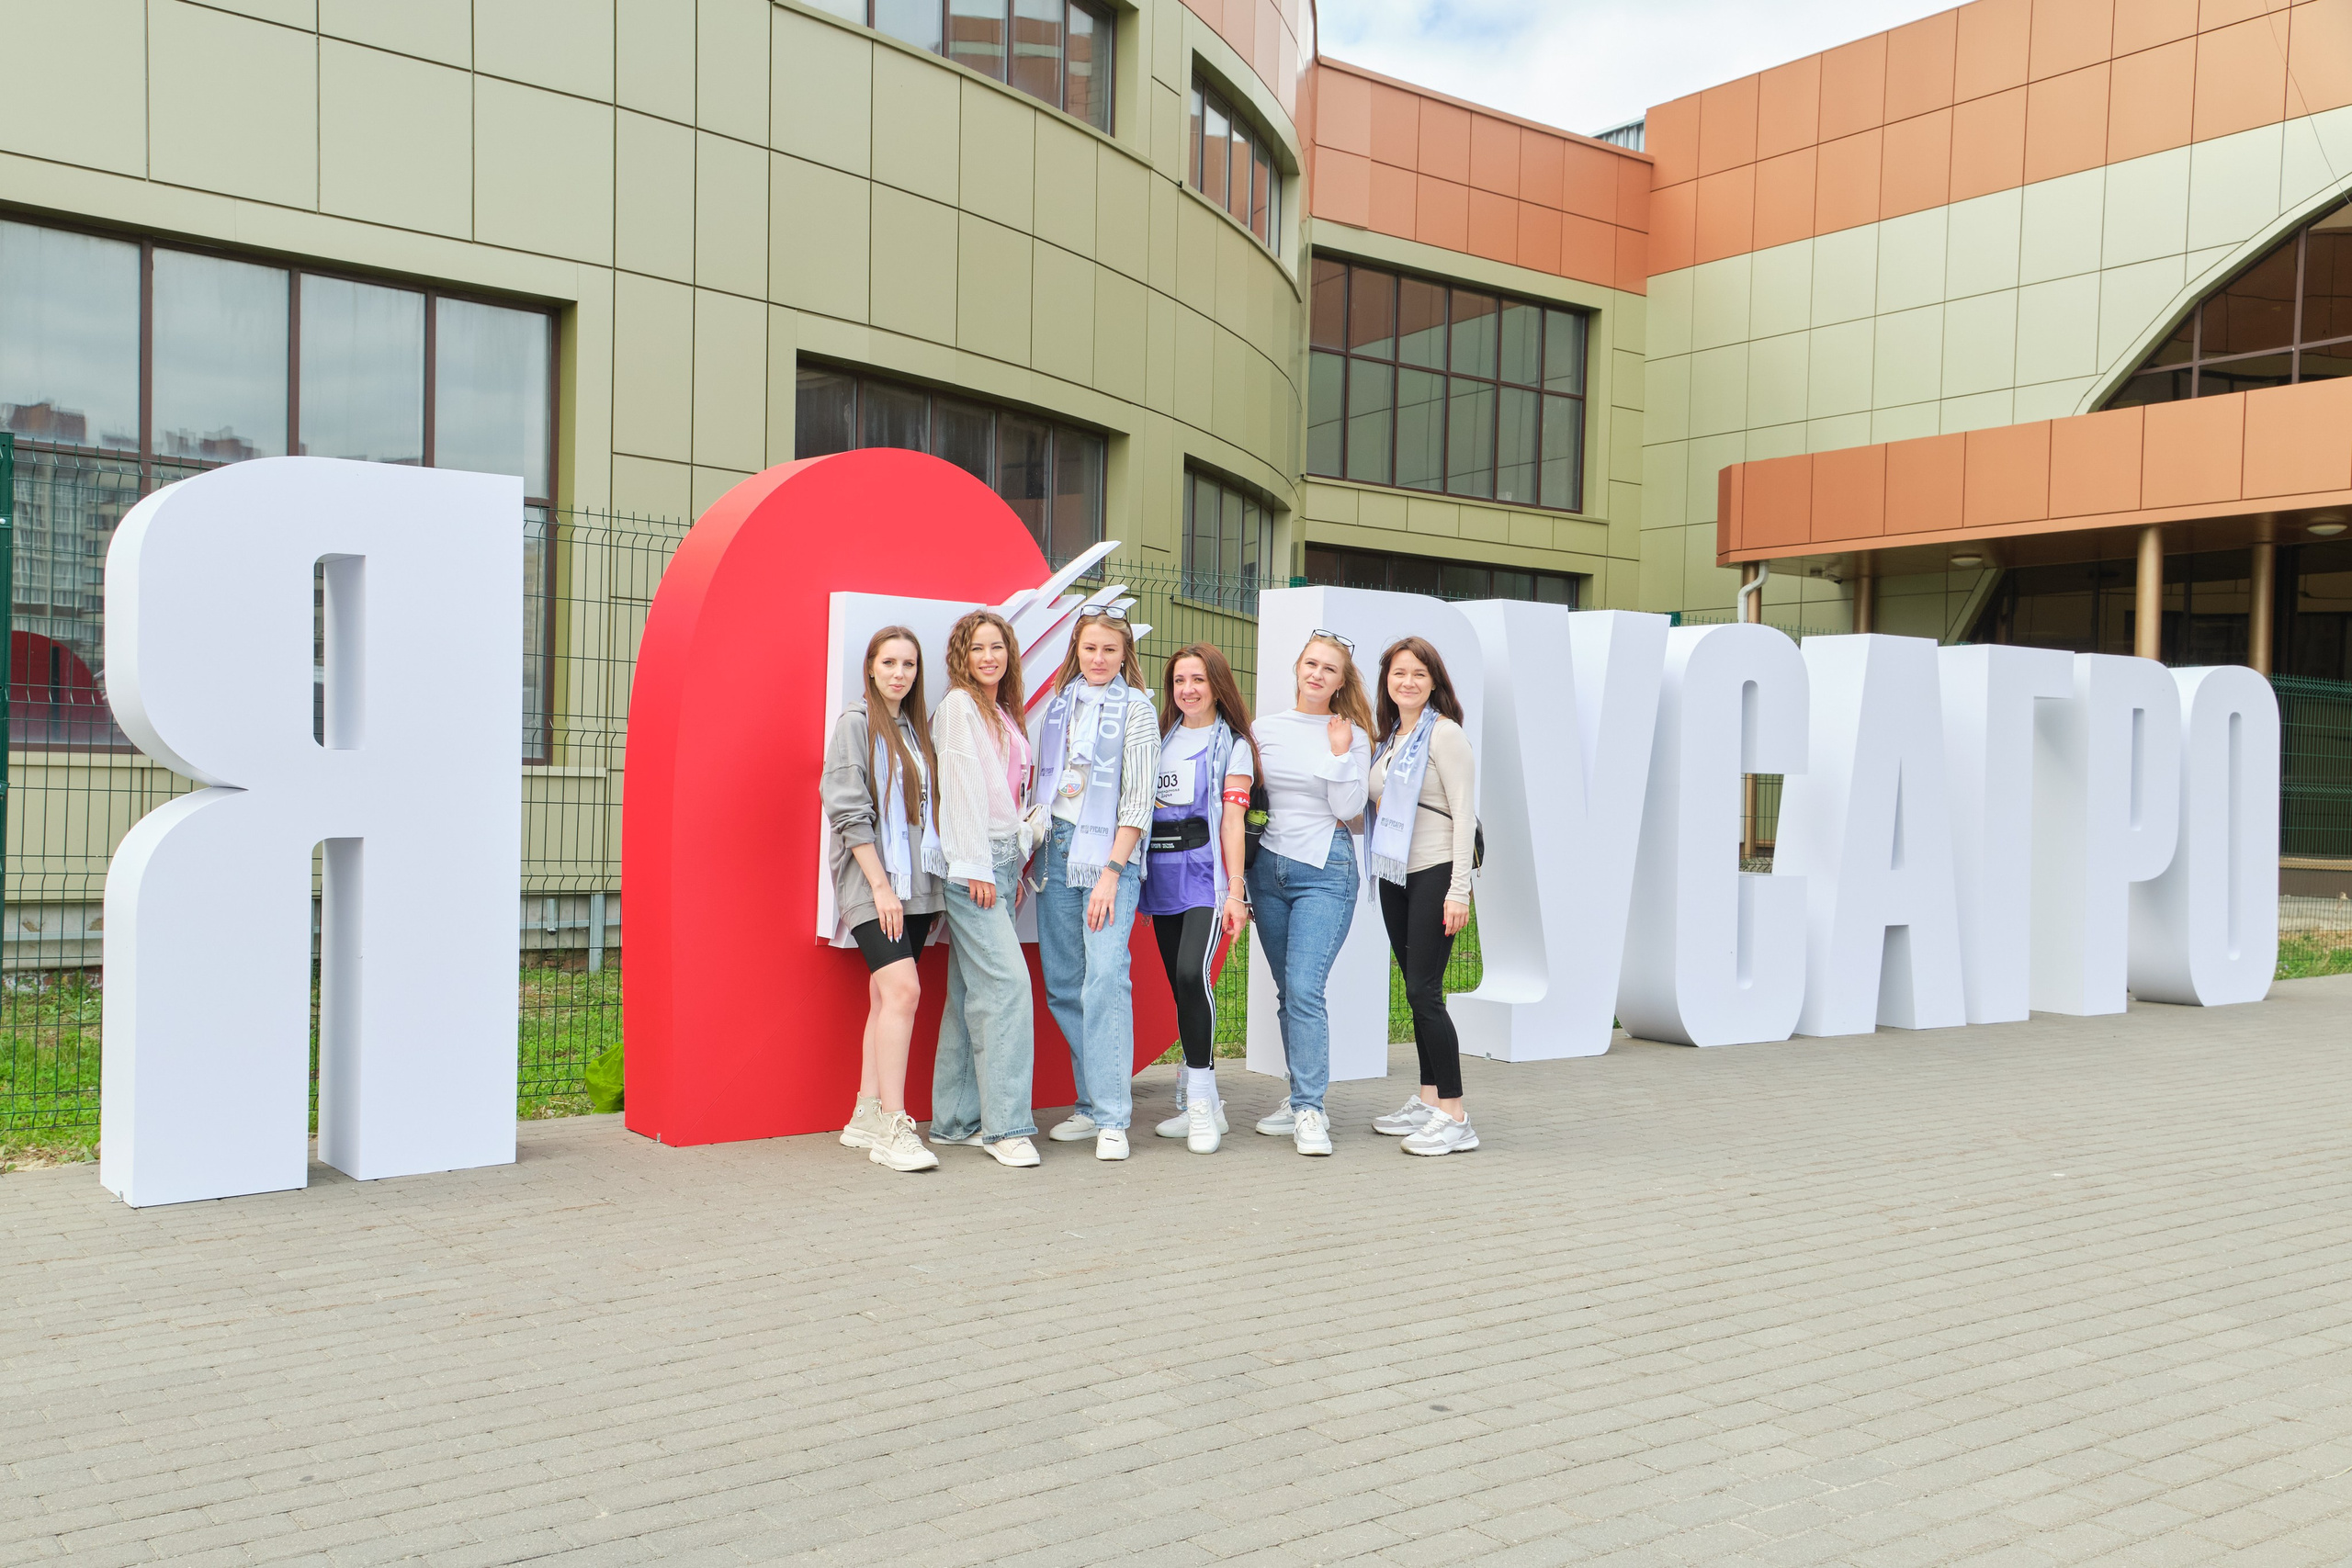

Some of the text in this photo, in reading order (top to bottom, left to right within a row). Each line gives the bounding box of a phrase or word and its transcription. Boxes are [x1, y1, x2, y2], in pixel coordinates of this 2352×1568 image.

[1091, 683, 1128, 788] ГК ОЦО
[100, 457, 524, 1208] Я
[1090, 825, 1109, 834] РУСАГРО
